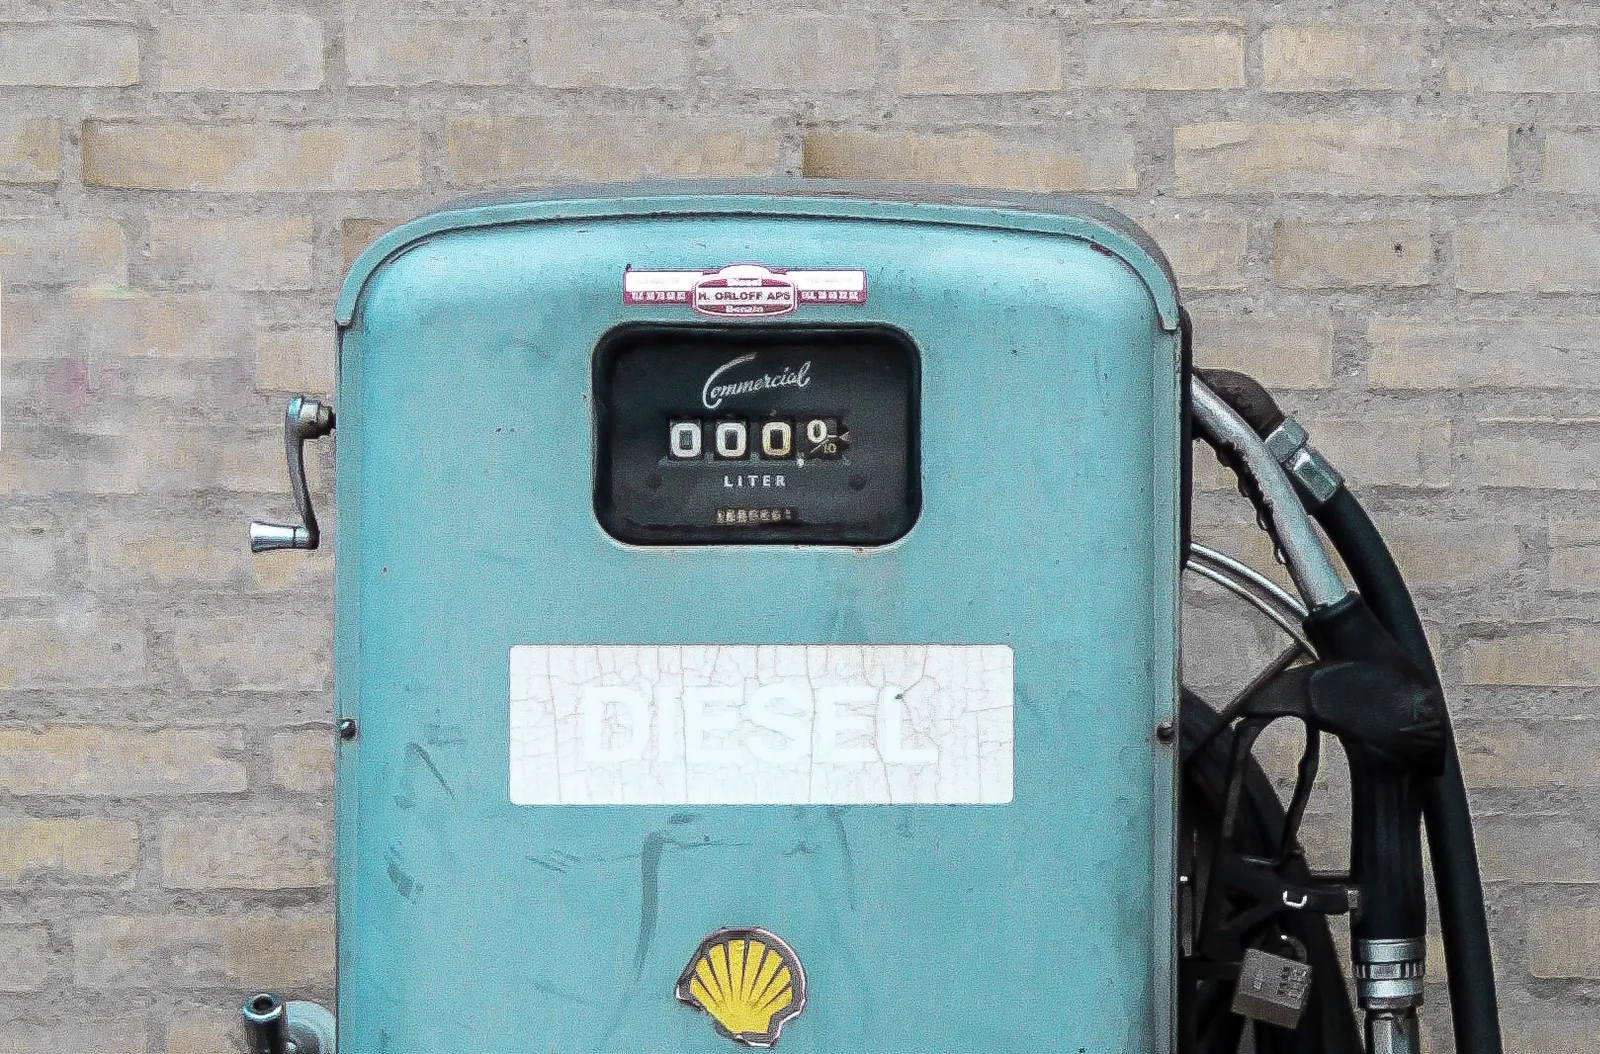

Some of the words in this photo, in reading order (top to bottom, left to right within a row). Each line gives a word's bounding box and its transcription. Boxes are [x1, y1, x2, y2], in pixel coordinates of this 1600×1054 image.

[714, 291, 763, 301] ORLOFF
[767, 291, 791, 301] APS
[702, 352, 811, 410] Commercial
[724, 475, 786, 488] LITER
[582, 684, 939, 764] DIESEL
